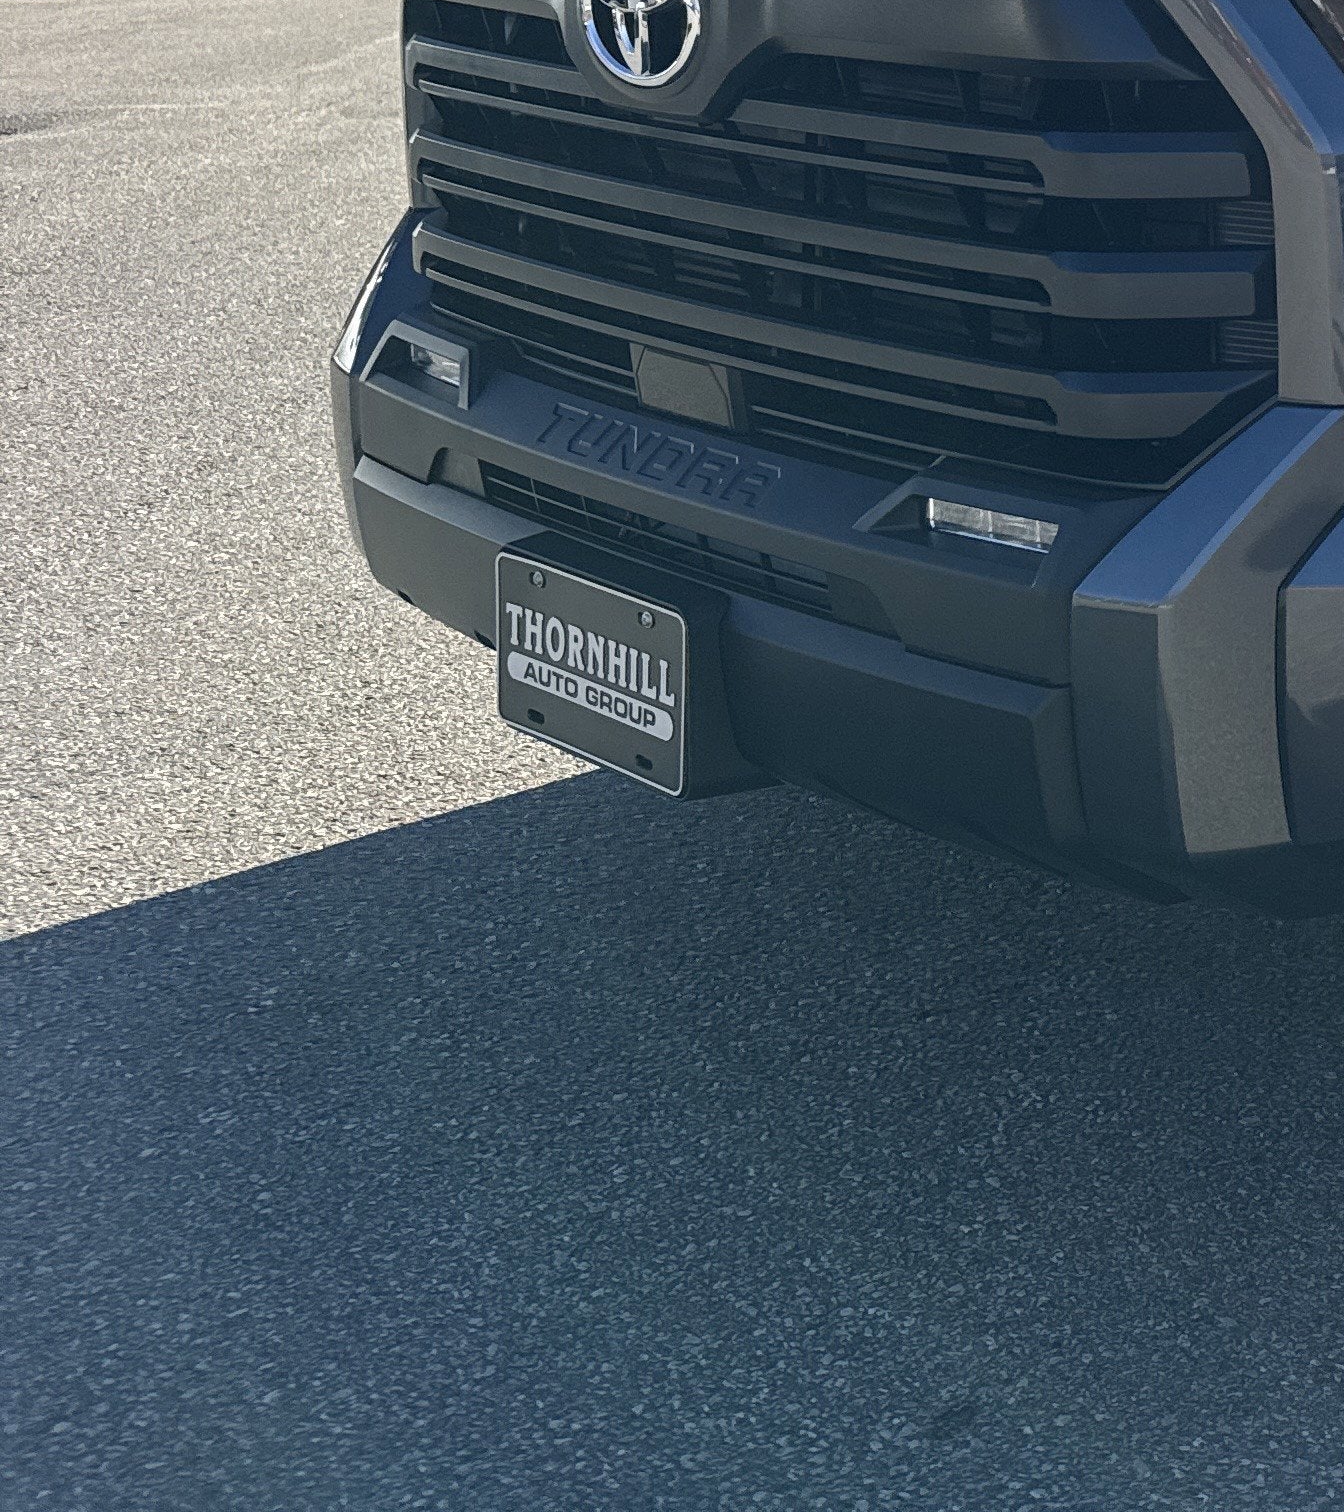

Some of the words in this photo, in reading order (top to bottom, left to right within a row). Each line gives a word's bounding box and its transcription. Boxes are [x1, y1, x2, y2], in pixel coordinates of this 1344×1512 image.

[536, 402, 781, 508] TUNDRA
[505, 602, 675, 707] THORNHILL
[523, 661, 580, 699] AUTO
[585, 685, 657, 729] GROUP
